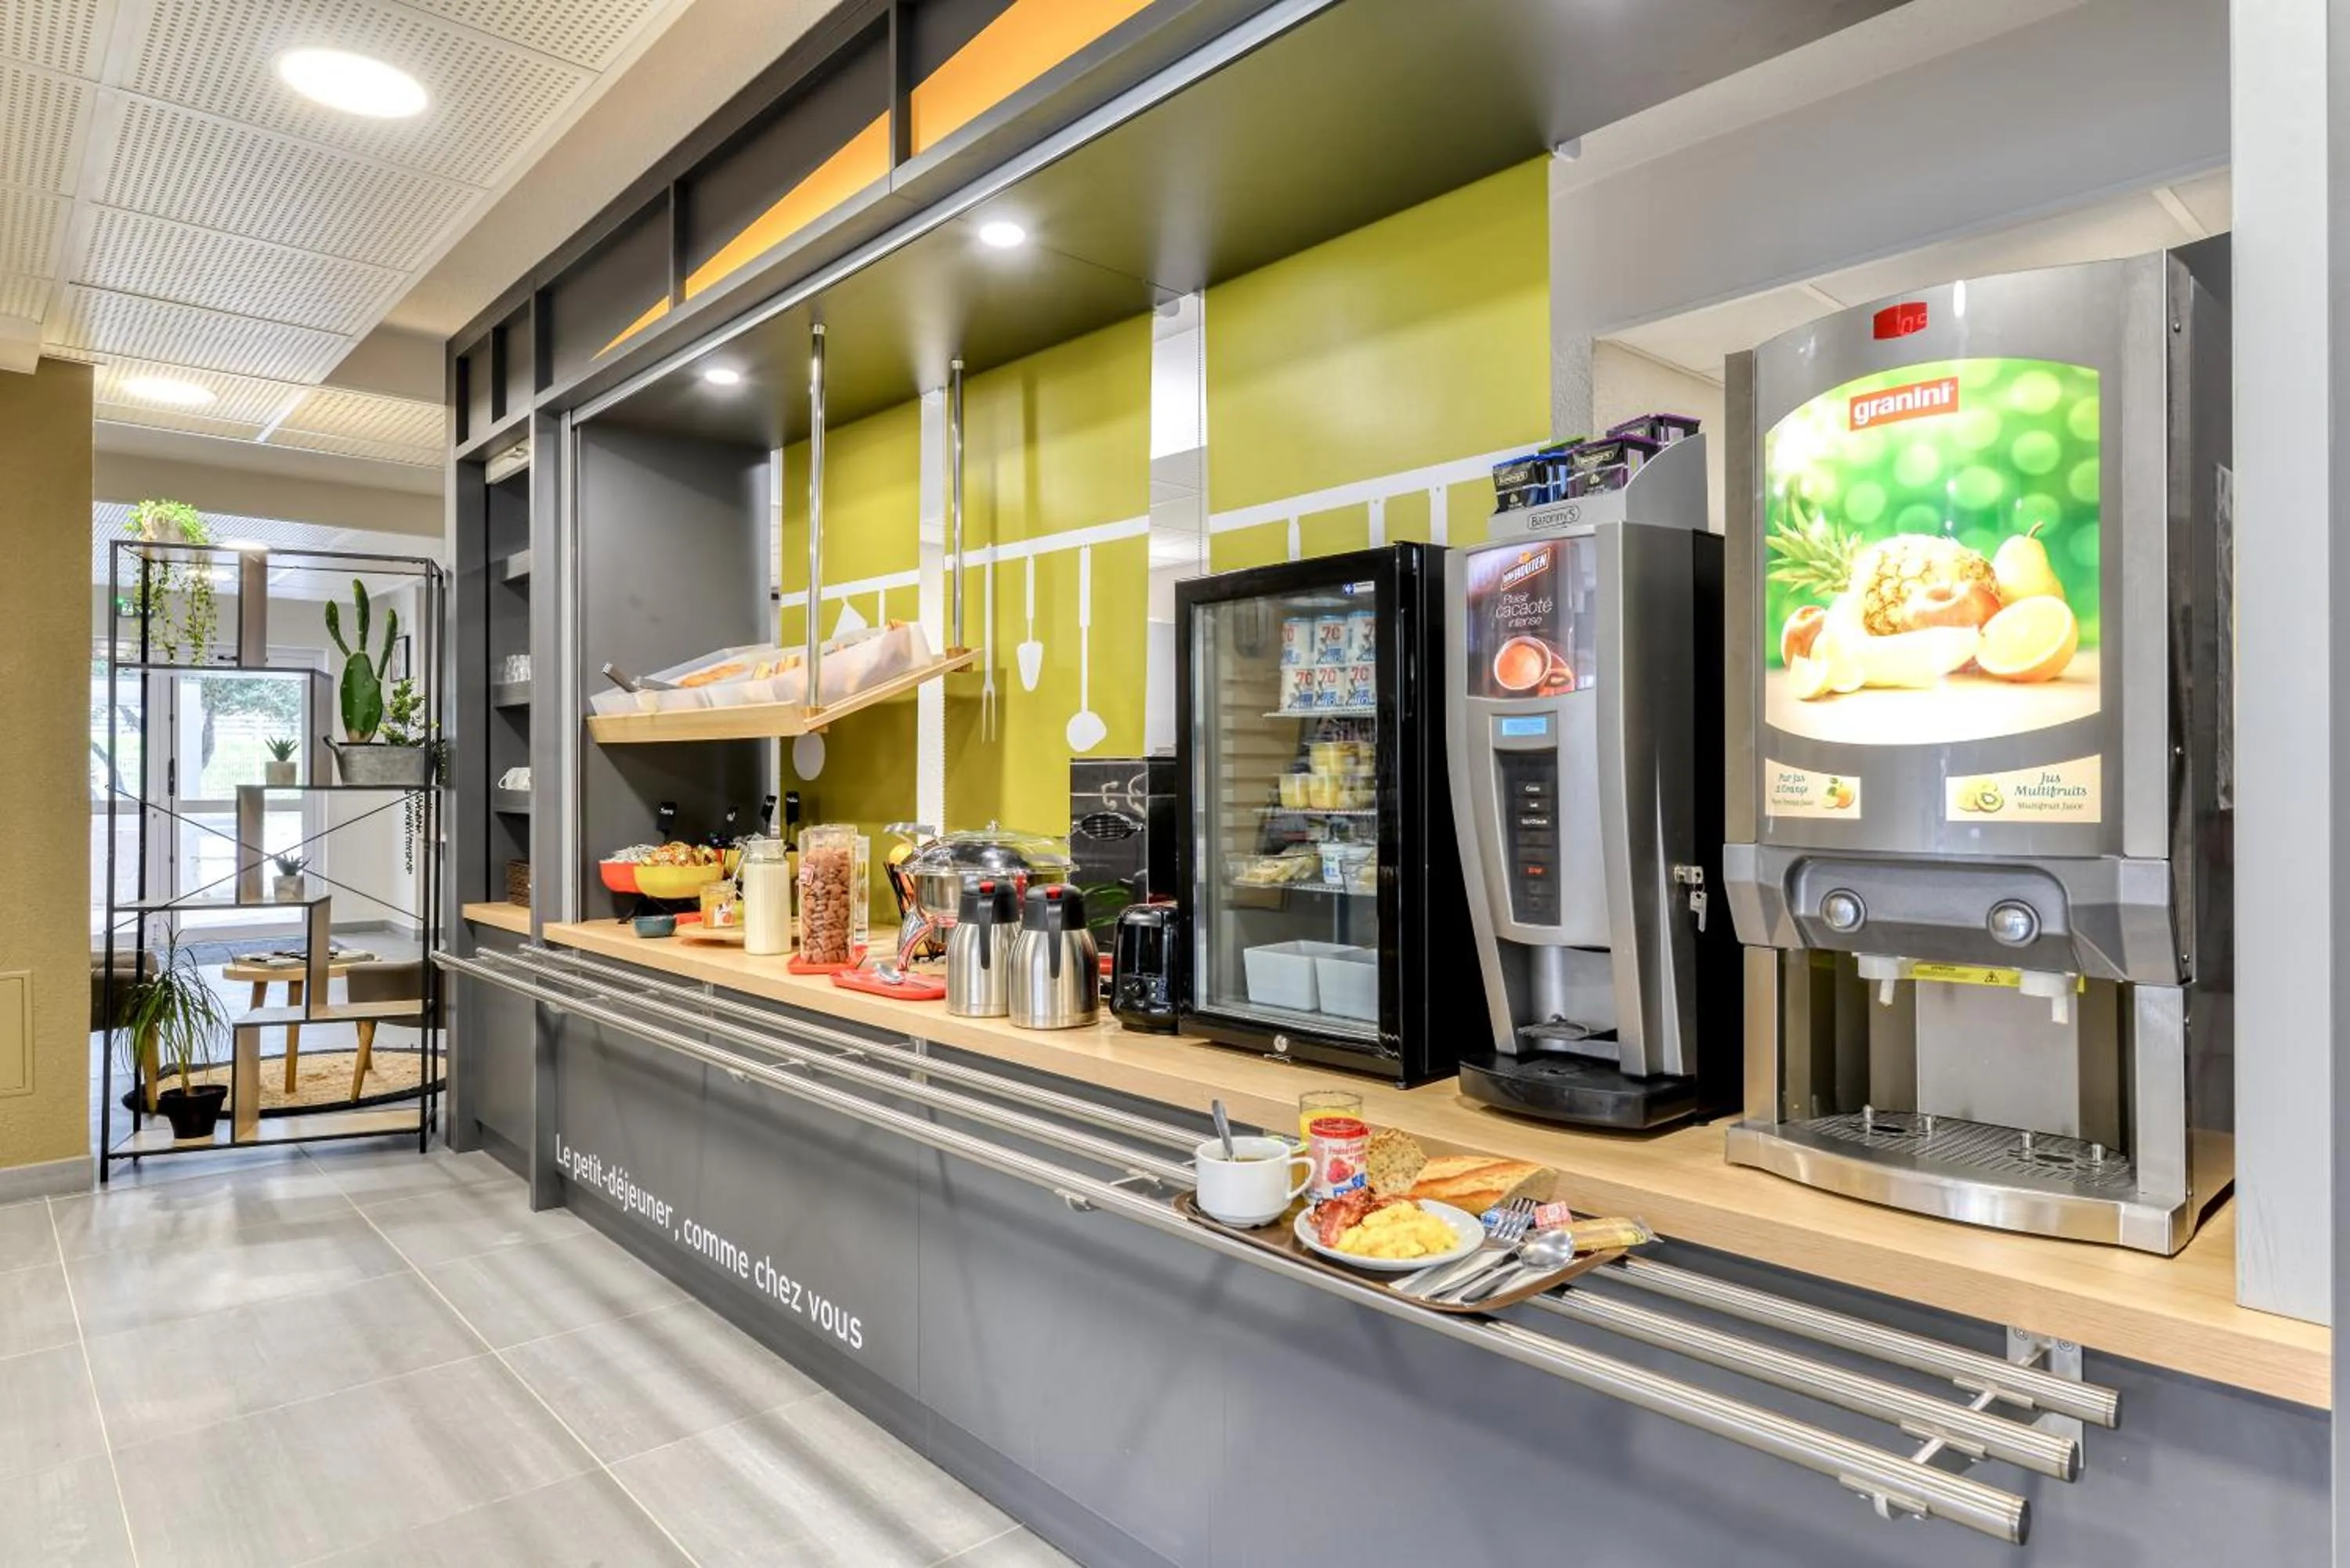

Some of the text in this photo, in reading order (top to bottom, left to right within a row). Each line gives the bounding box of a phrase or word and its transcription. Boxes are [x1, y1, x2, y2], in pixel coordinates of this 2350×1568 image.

[1853, 381, 1950, 426] granini
[1321, 625, 1340, 641] 70
[1296, 671, 1314, 686] 70
[1319, 669, 1336, 684] 70
[1351, 667, 1369, 682] 70
[2039, 771, 2060, 786] Jus
[2014, 786, 2087, 798] Multifruits
[556, 1133, 570, 1168] Le
[573, 1151, 673, 1229] petit-déjeuner
[684, 1218, 749, 1279] comme
[754, 1255, 802, 1313] chez
[808, 1290, 862, 1349] vous
